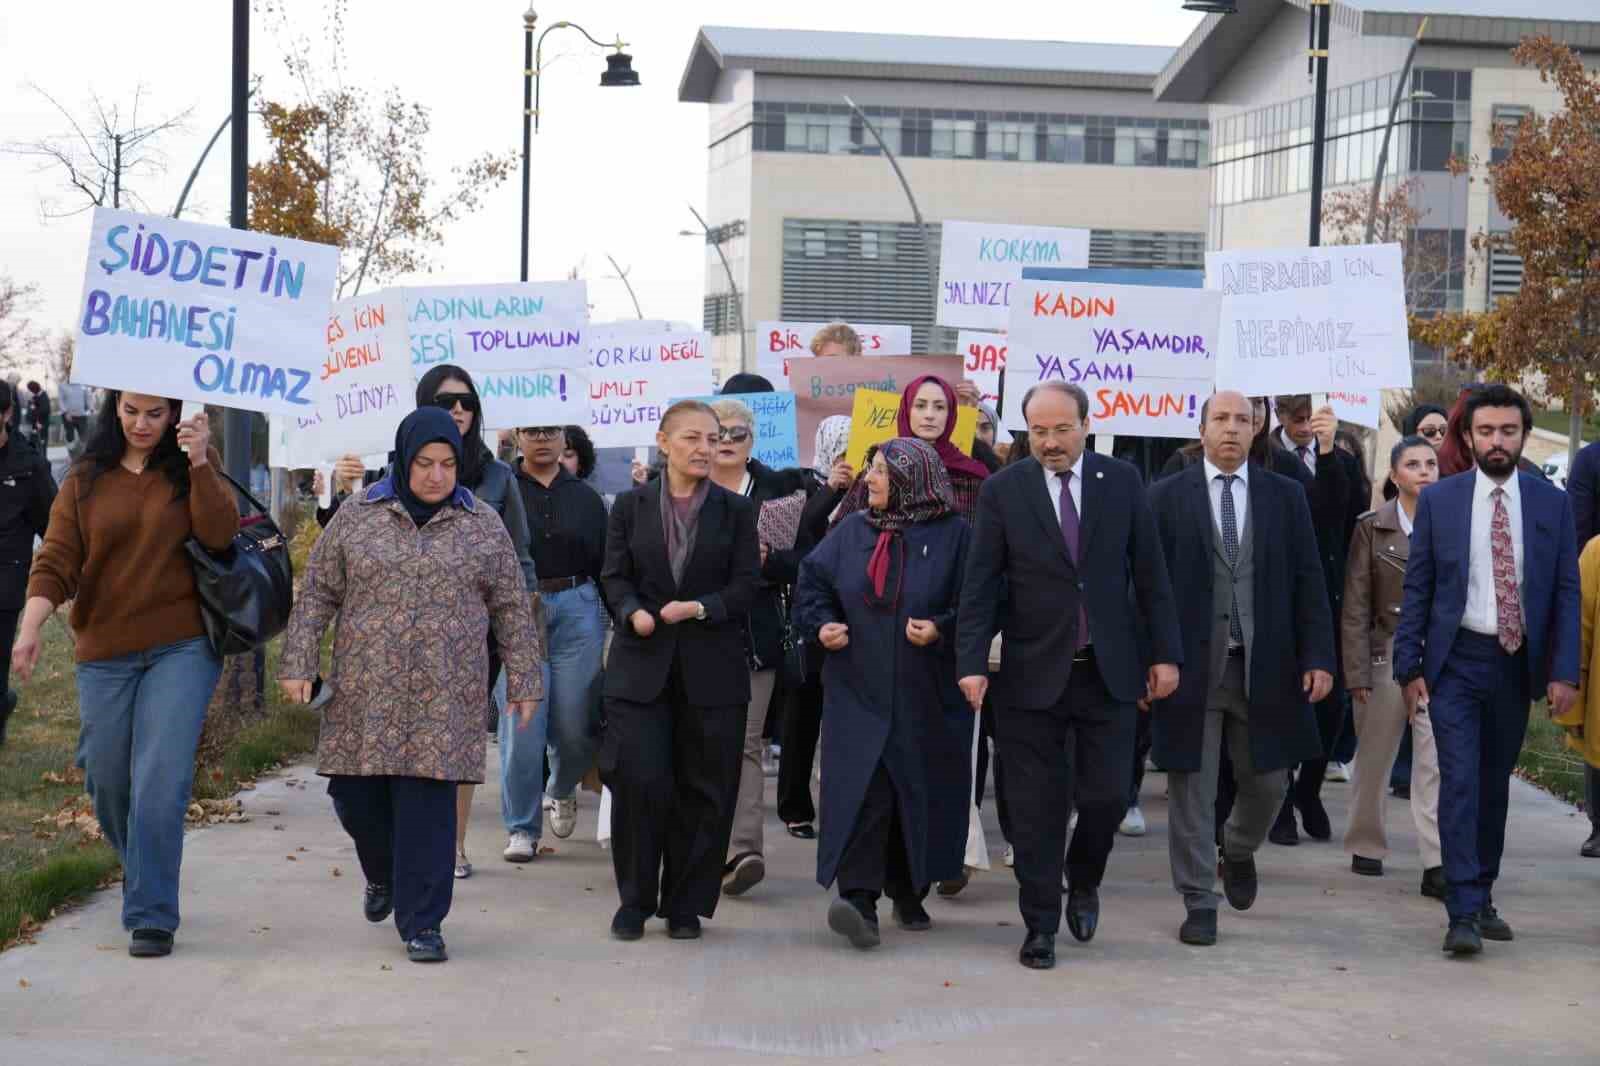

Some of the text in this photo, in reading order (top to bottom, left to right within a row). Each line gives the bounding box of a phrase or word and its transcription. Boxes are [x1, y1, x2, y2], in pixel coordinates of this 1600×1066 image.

[99, 223, 305, 299] ŞİDDETİN
[978, 236, 1062, 263] KORKMA
[1221, 256, 1332, 296] NERMİN
[82, 289, 236, 350] BAHANESİ
[408, 296, 544, 323] ADINLARIN
[1033, 291, 1116, 319] KADIN
[465, 329, 581, 353] TOPLUMUN
[588, 339, 705, 368] ORKU DEĞİL
[769, 328, 803, 353] BİR
[1092, 327, 1211, 359] YAŞAMDIR,
[193, 354, 312, 405] OLMAZ
[590, 379, 648, 399] UMUT
[335, 382, 398, 420] DÜNYA
